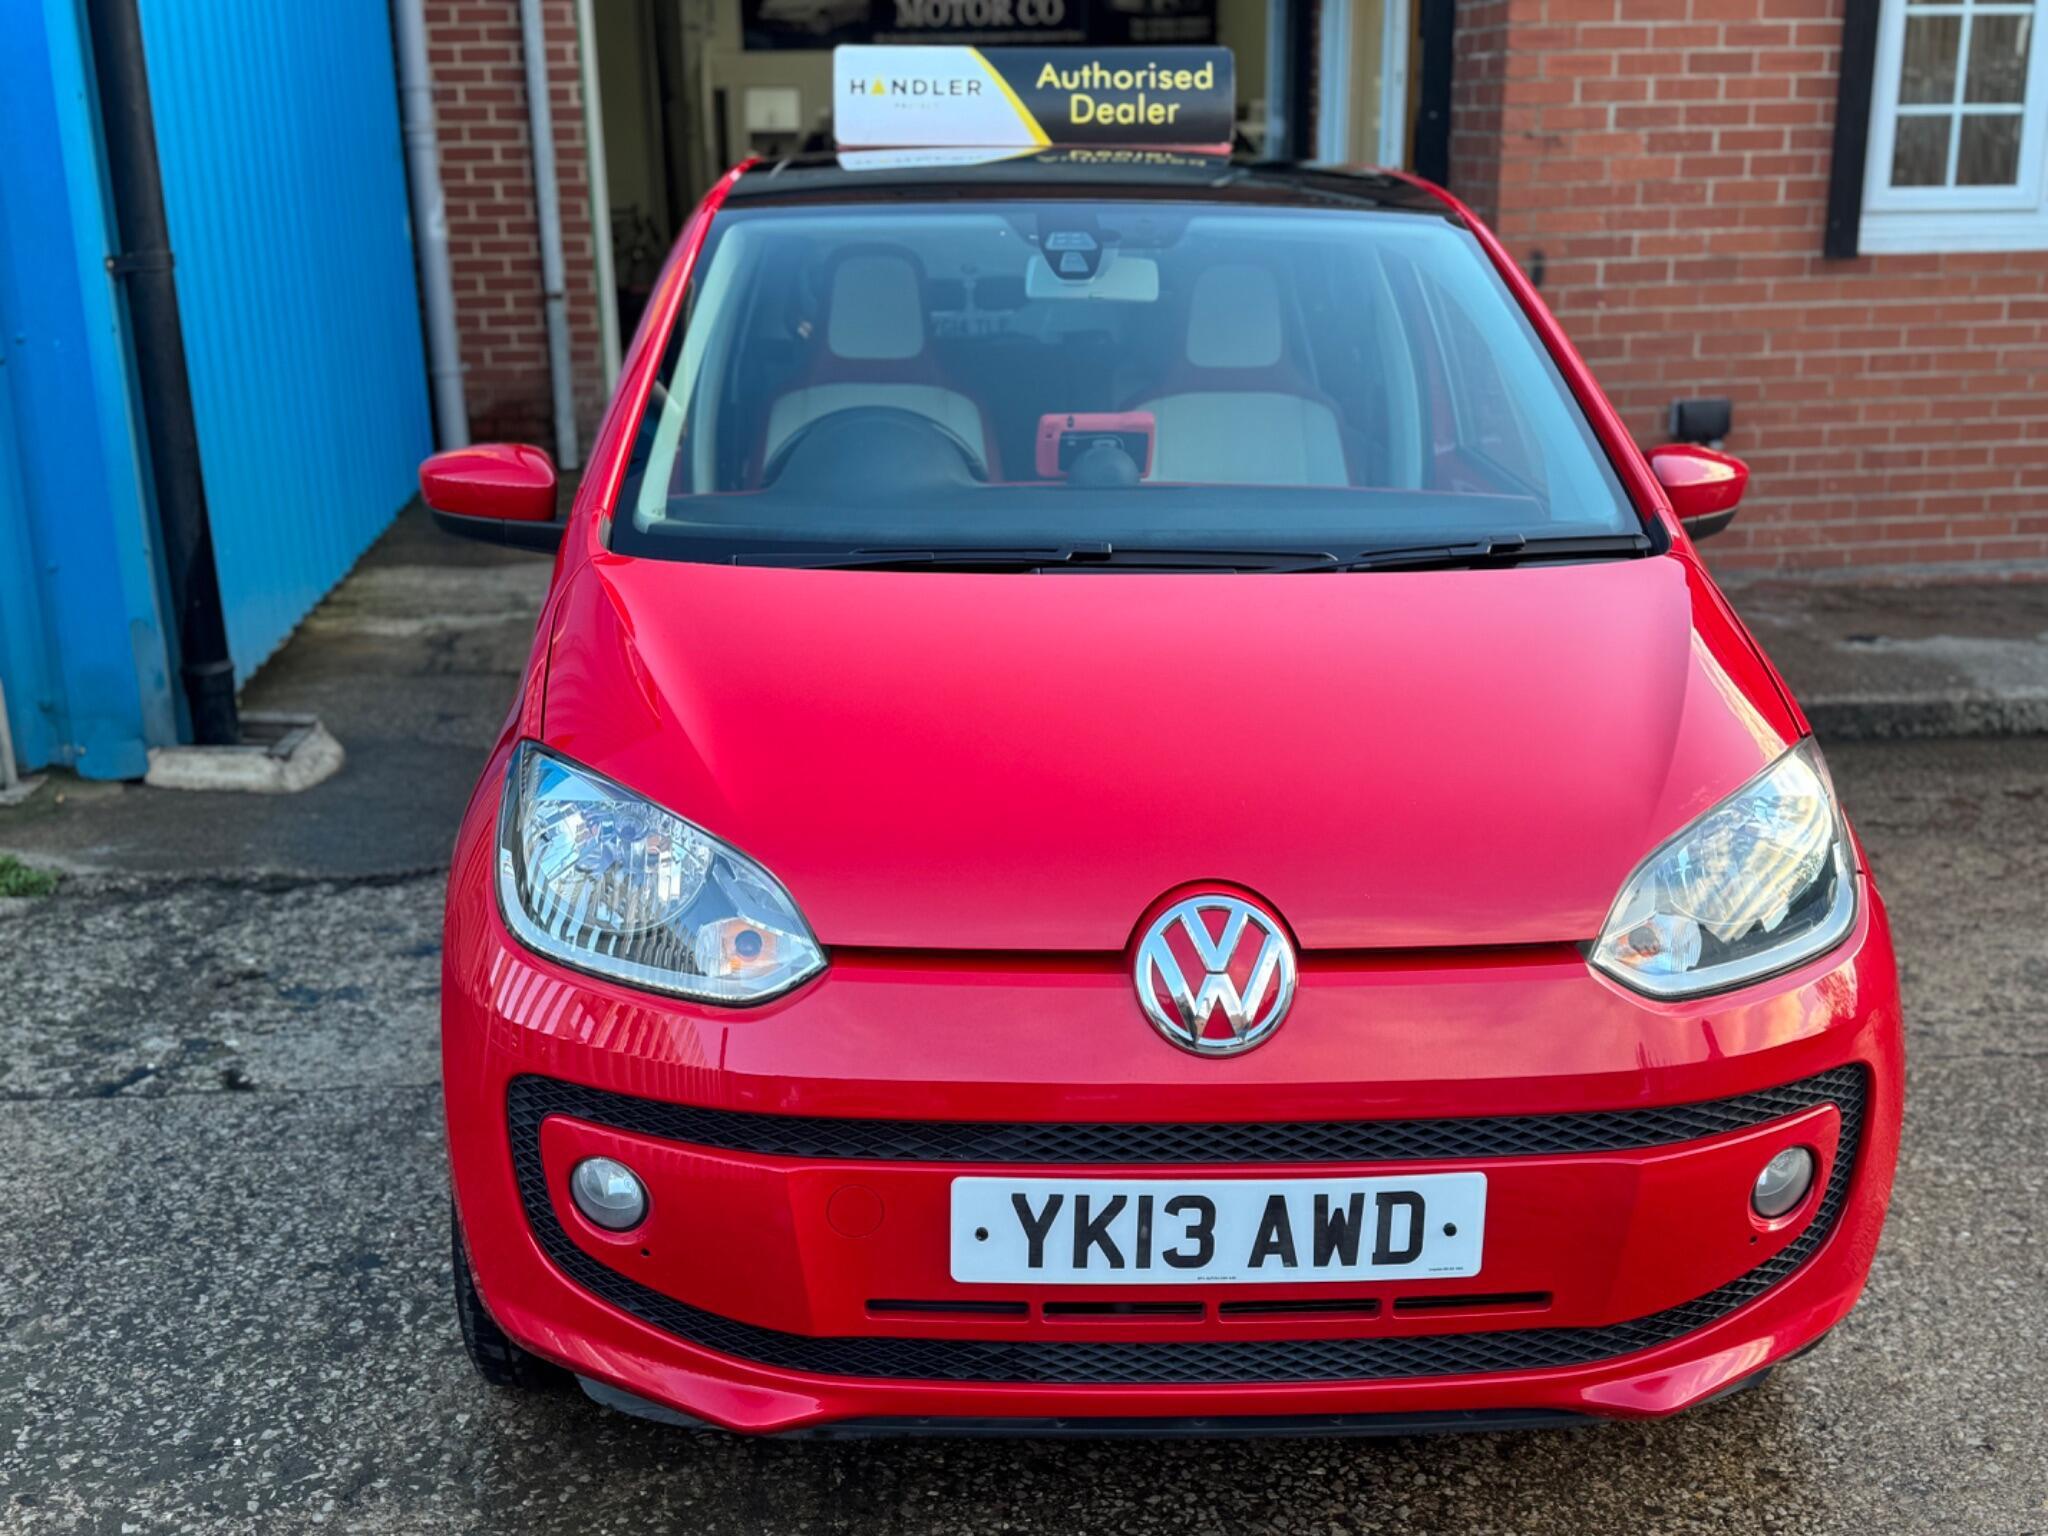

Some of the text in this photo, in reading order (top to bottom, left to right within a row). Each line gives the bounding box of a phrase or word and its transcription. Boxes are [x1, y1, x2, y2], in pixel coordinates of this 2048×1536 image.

[895, 0, 1065, 28] MOTOR CO
[849, 79, 982, 96] HANDLER
[1035, 61, 1214, 91] Authorised
[1069, 92, 1181, 125] Dealer
[1011, 1191, 1426, 1269] YK13 AWD
